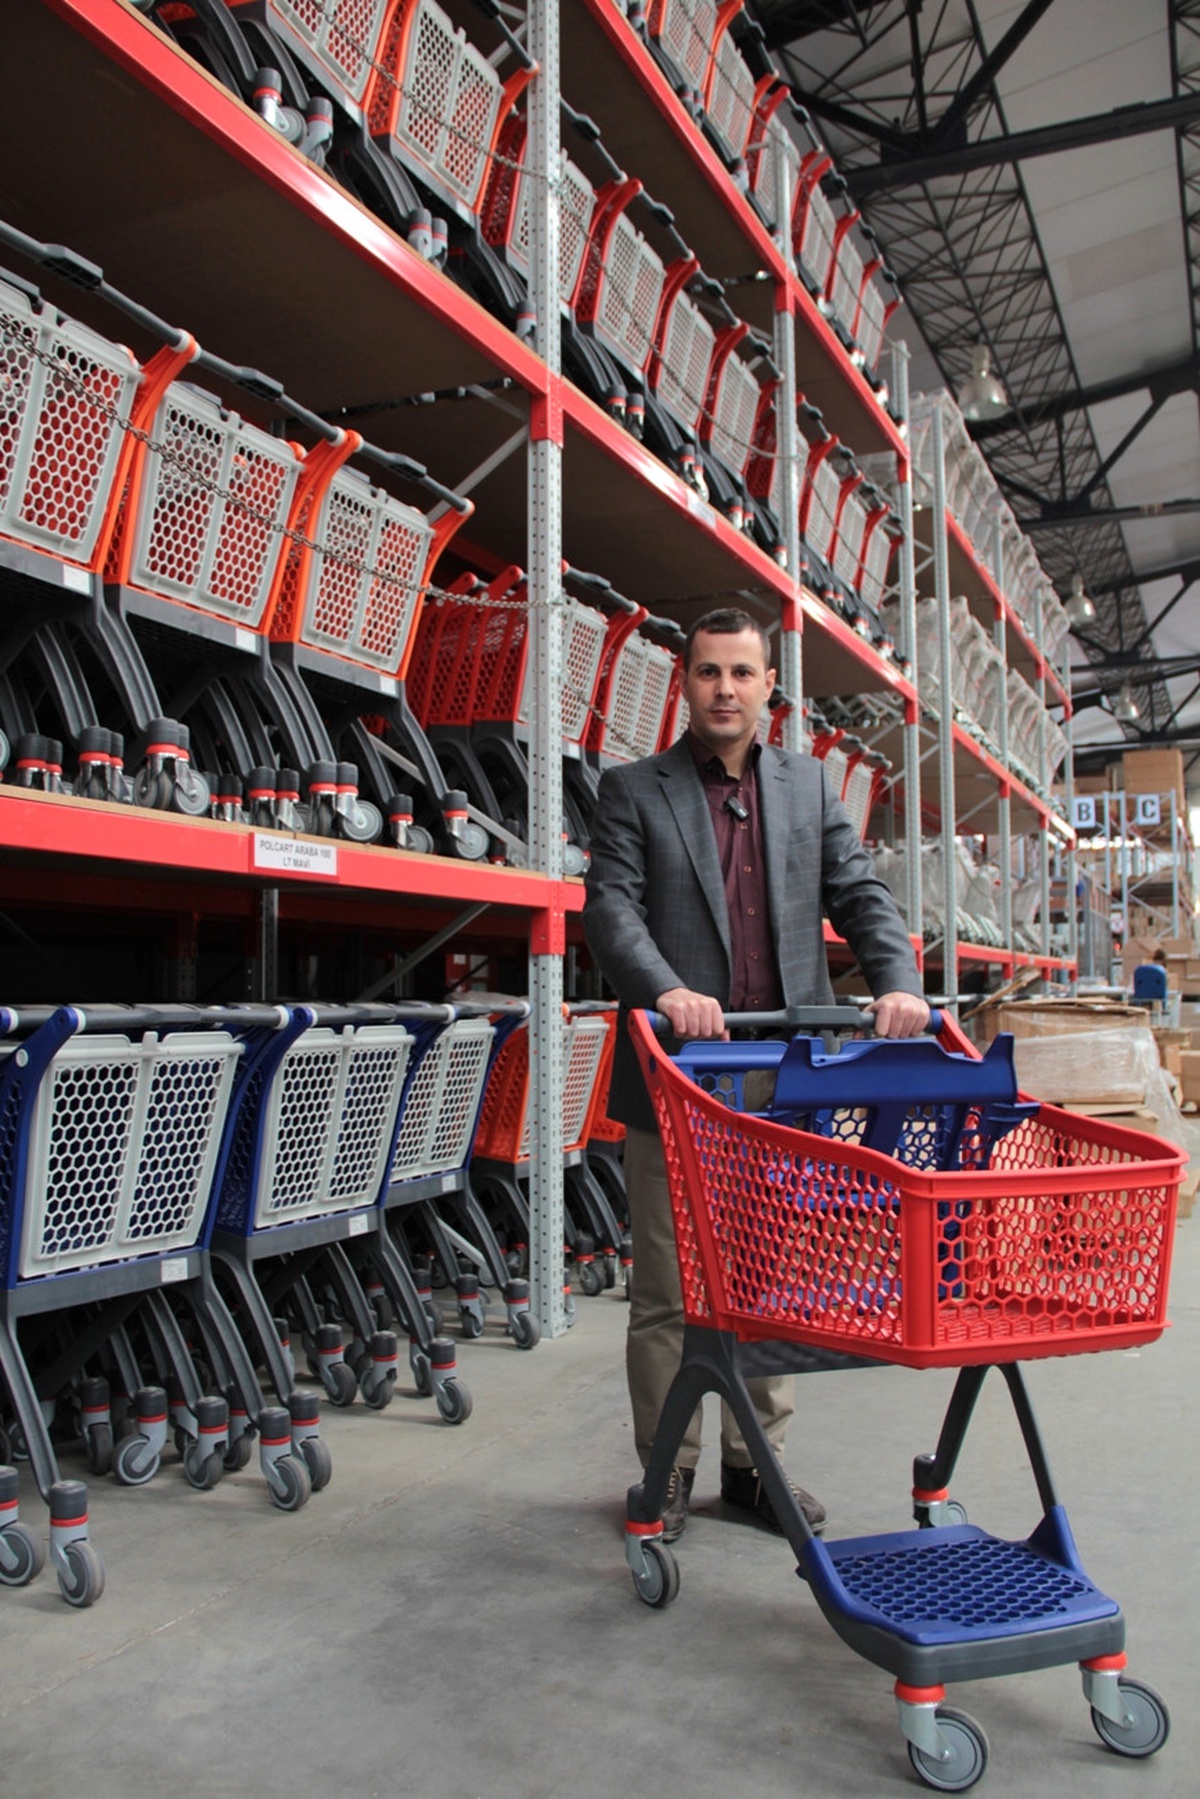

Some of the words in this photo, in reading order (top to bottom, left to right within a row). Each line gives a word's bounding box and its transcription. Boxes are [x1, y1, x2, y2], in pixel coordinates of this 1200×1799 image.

[1077, 802, 1091, 821] B
[1141, 799, 1155, 818] C
[260, 840, 293, 853] POLCART
[295, 846, 319, 857] ARABA
